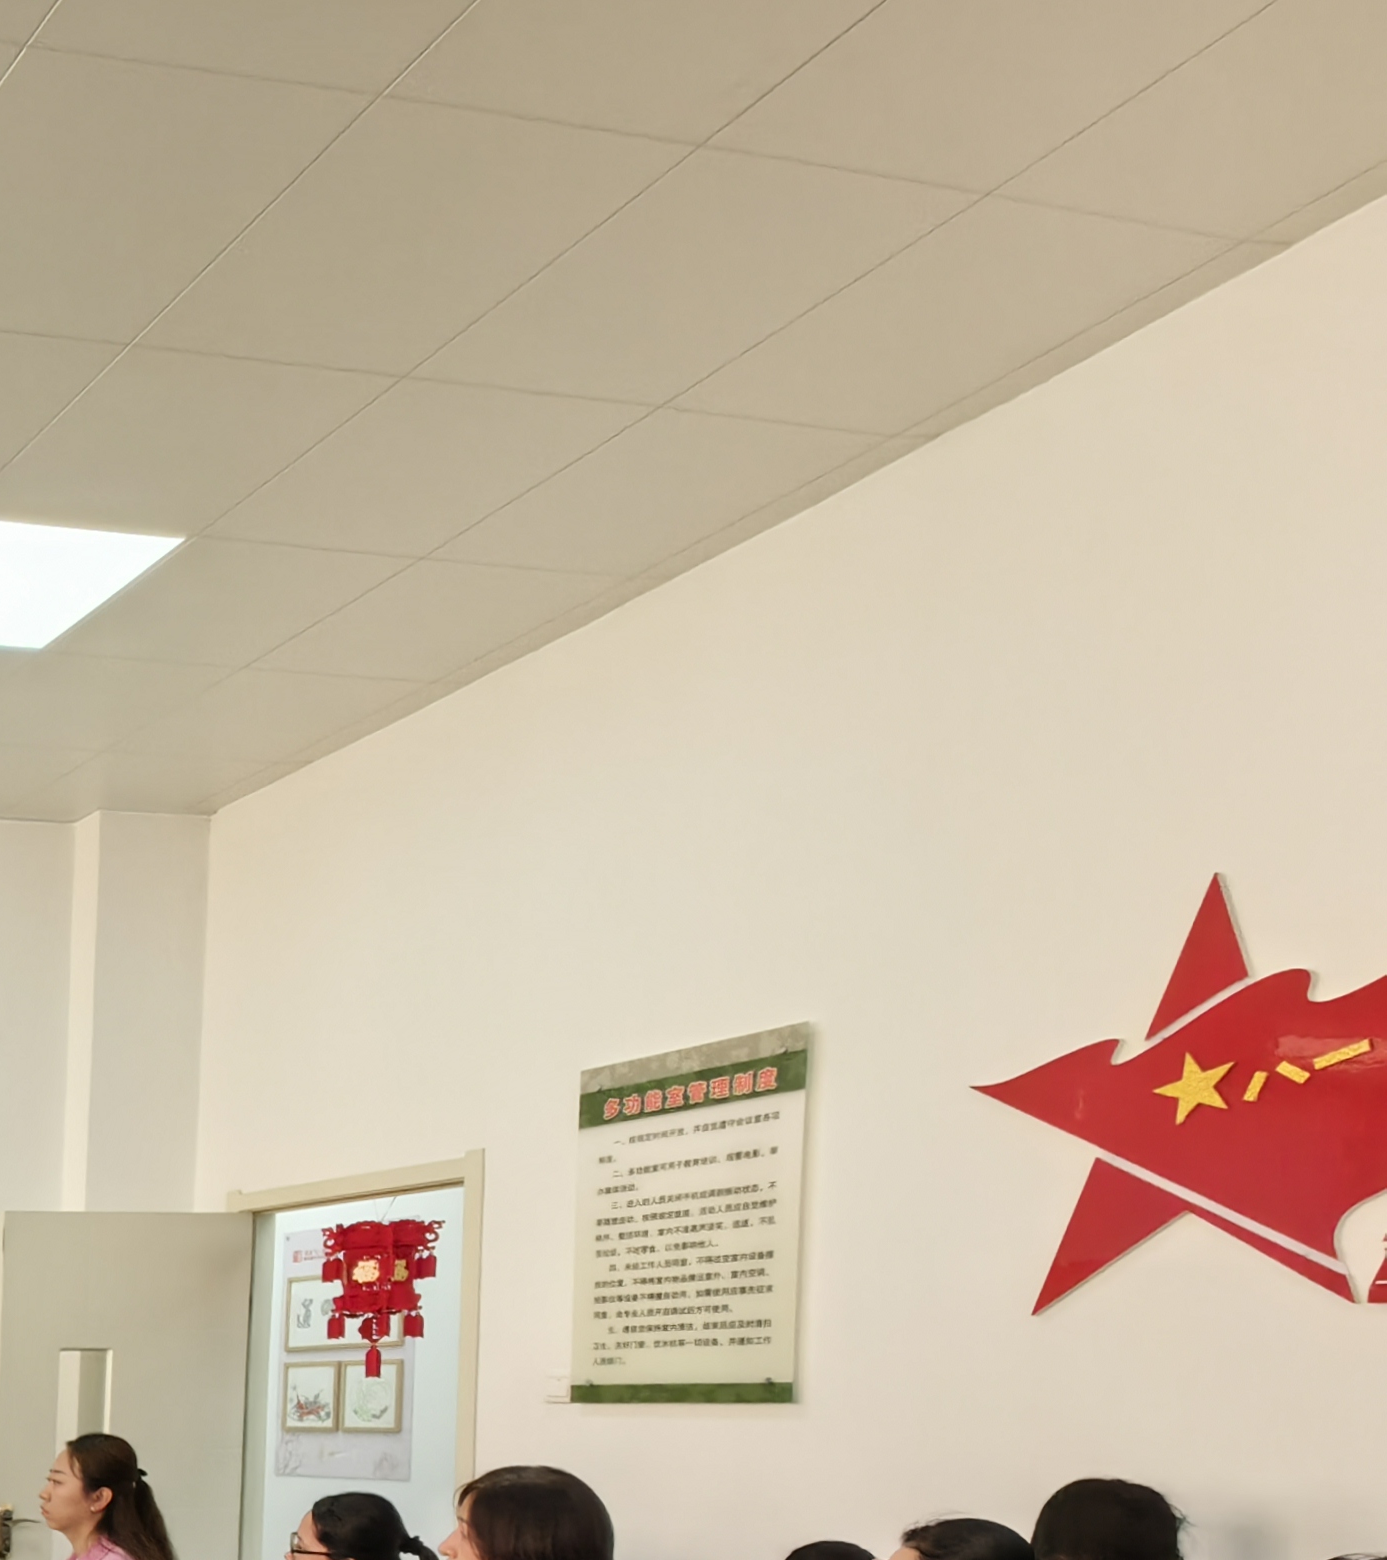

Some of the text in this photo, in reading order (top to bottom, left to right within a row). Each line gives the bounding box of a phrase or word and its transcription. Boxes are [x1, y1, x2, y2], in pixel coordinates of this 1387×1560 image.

[603, 1066, 778, 1120] 多功能室管理制度
